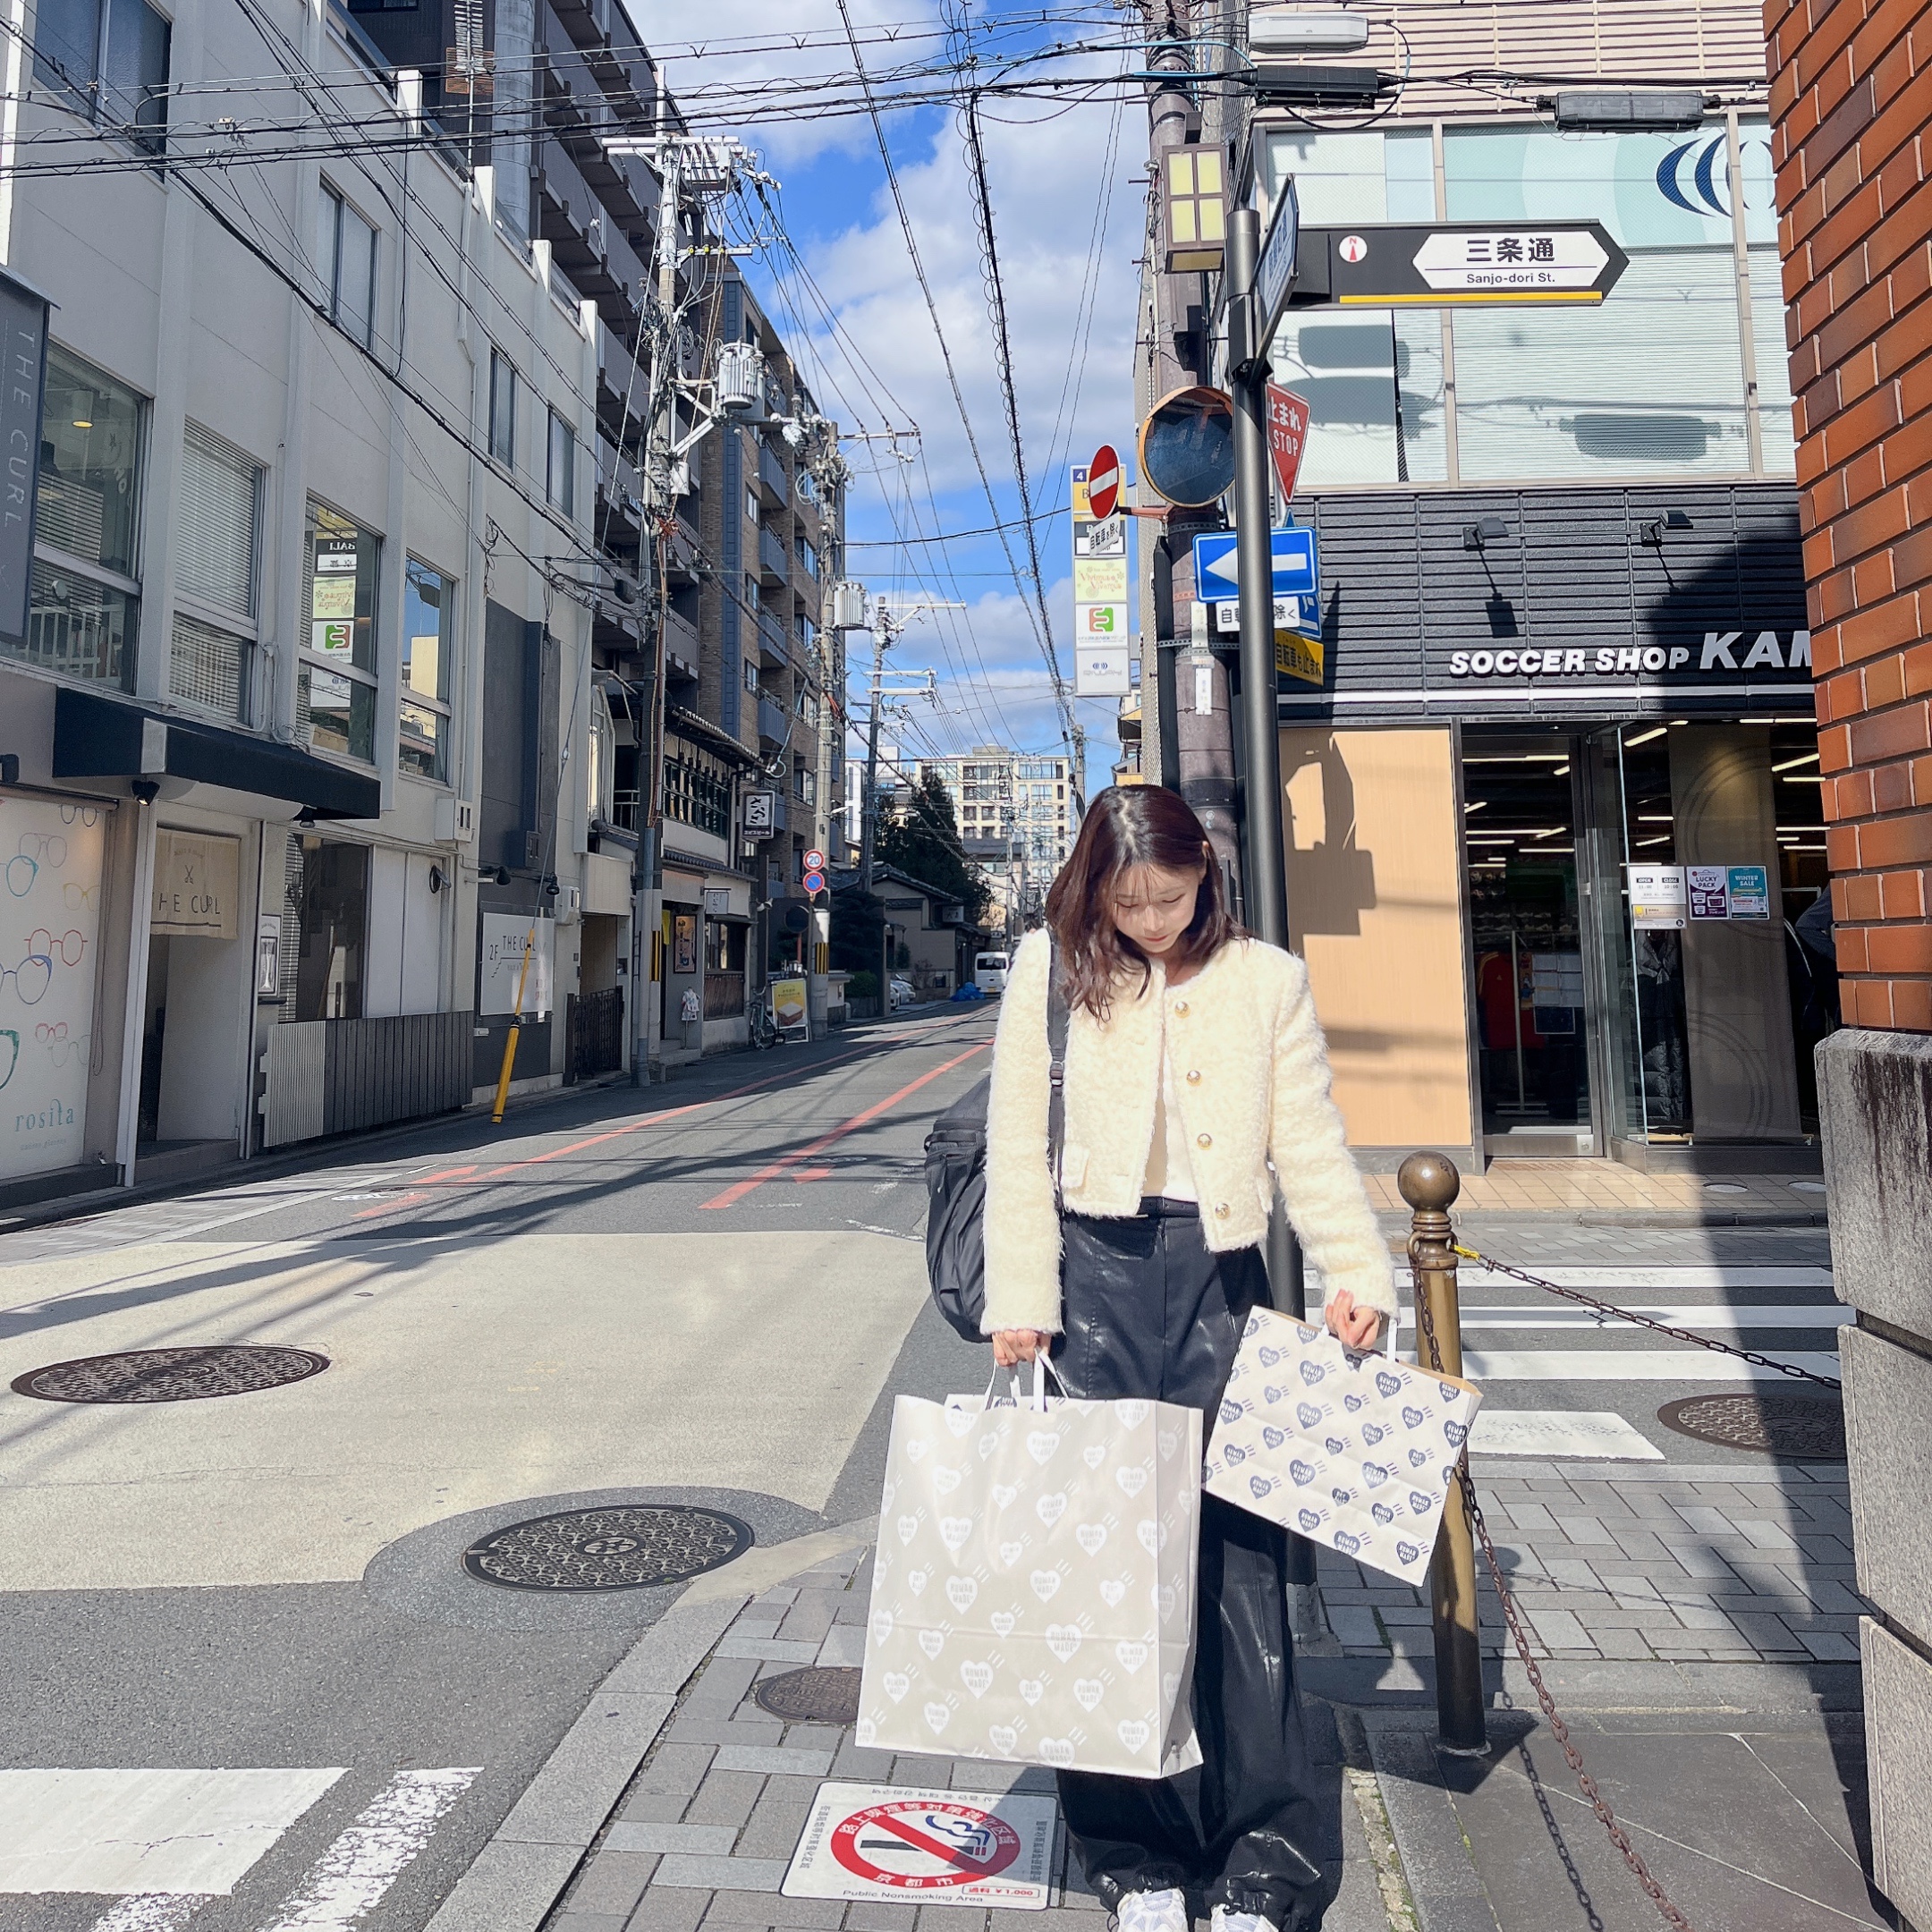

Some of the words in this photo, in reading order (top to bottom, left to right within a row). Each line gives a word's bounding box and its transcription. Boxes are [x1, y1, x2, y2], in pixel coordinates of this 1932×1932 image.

[1466, 237, 1555, 263] 三条通
[1466, 272, 1534, 285] Sanjo-dori
[1538, 272, 1555, 283] St.
[13, 330, 36, 409] THE
[1267, 396, 1302, 431] 止まれ
[1273, 429, 1299, 456] STOP
[4, 428, 29, 528] CURL
[1076, 471, 1084, 480] 4
[1222, 604, 1296, 624] 自除く
[1448, 648, 1588, 676] SOCCER
[1594, 646, 1690, 673] SHOP
[809, 855, 820, 865] 20
[151, 893, 181, 912] HE
[489, 945, 498, 961] 2F
[503, 936, 517, 950] THE
[519, 936, 536, 951] CUL
[15, 1098, 73, 1131] rosita
[1379, 1376, 1398, 1387] HUMAN
[874, 1873, 953, 1887] 京都市
[843, 1889, 877, 1897] Public
[881, 1892, 953, 1902] Nonsmoking
